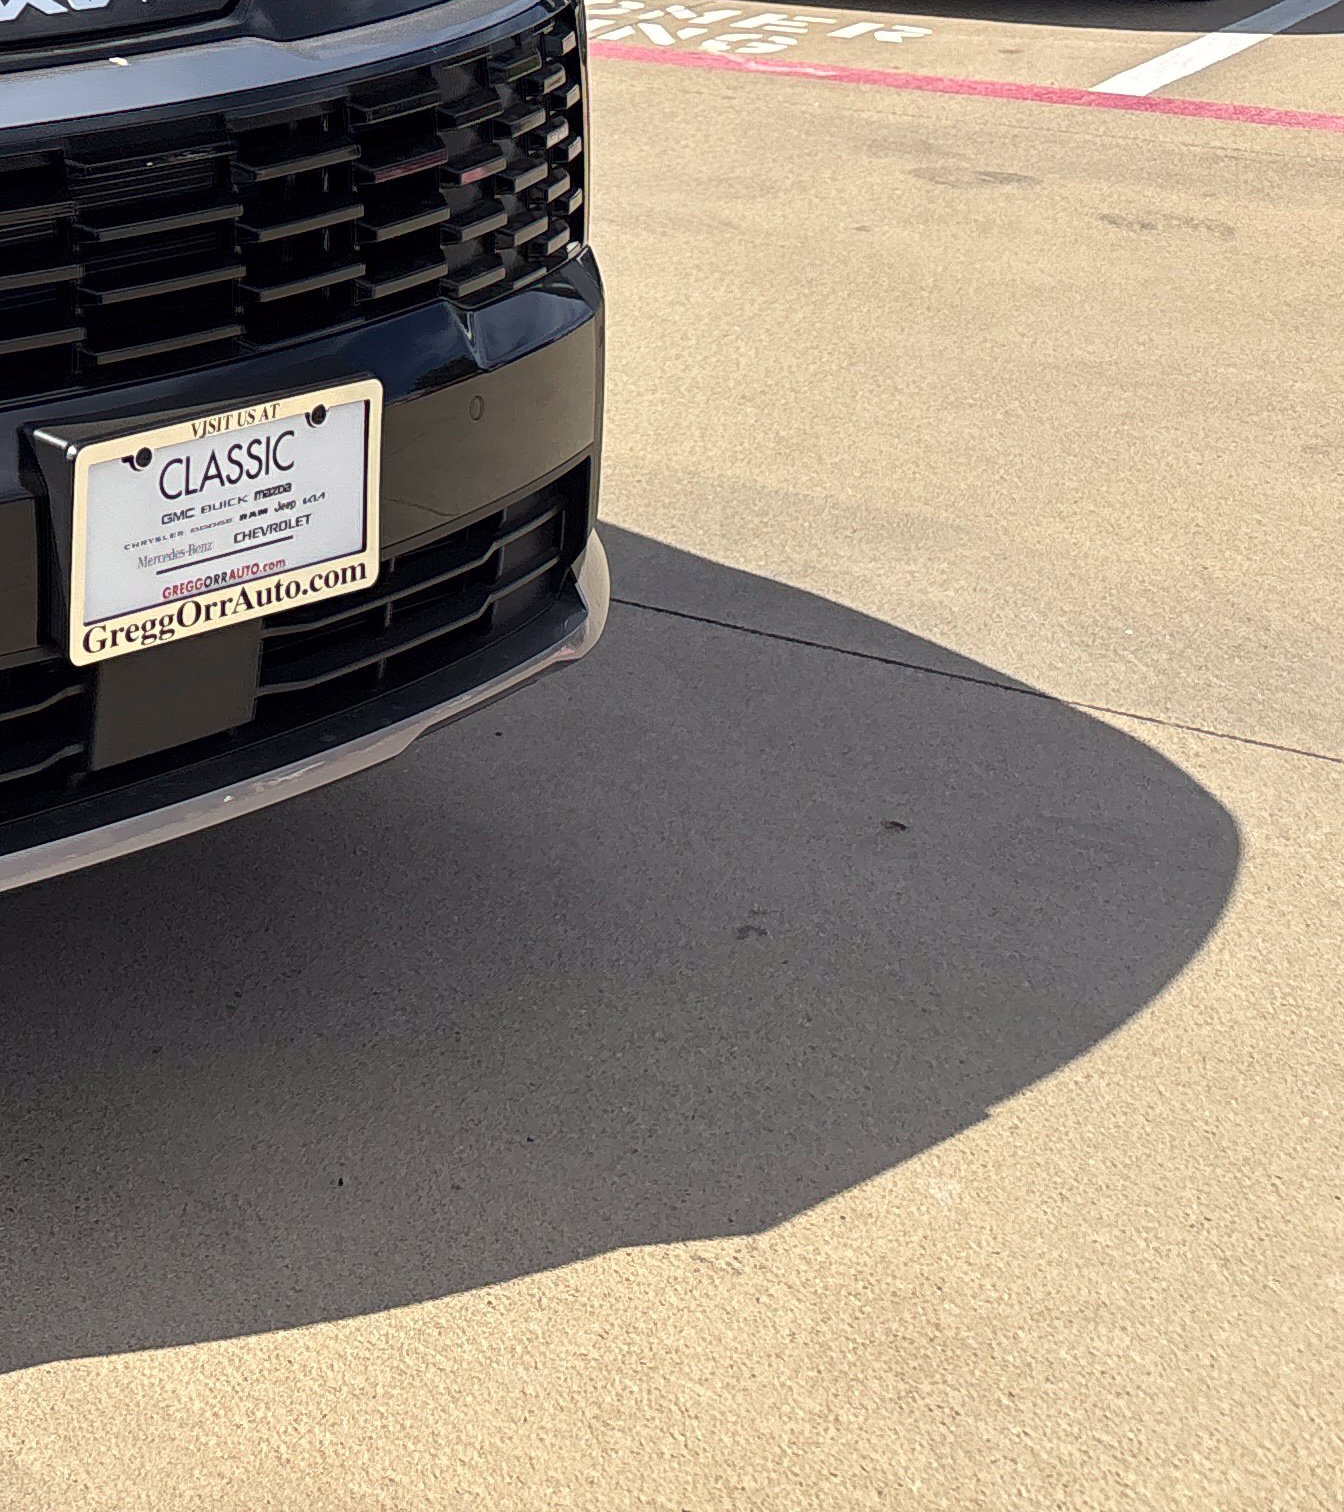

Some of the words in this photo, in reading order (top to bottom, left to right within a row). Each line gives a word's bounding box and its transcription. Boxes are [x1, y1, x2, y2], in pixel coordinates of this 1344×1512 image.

[190, 415, 234, 439] VISIT
[237, 408, 258, 427] US
[258, 403, 281, 423] AT
[159, 430, 295, 500] CLASSIC
[161, 507, 196, 525] GMC
[200, 495, 249, 514] BUICK
[239, 507, 269, 522] RAM
[273, 499, 297, 513] Jeep
[136, 541, 214, 569] Mercedes-Benz
[233, 514, 313, 544] CHEVROLET
[162, 558, 286, 600] GREGGORRAUTO.com
[82, 562, 368, 654] GreggOrrAuto.com
